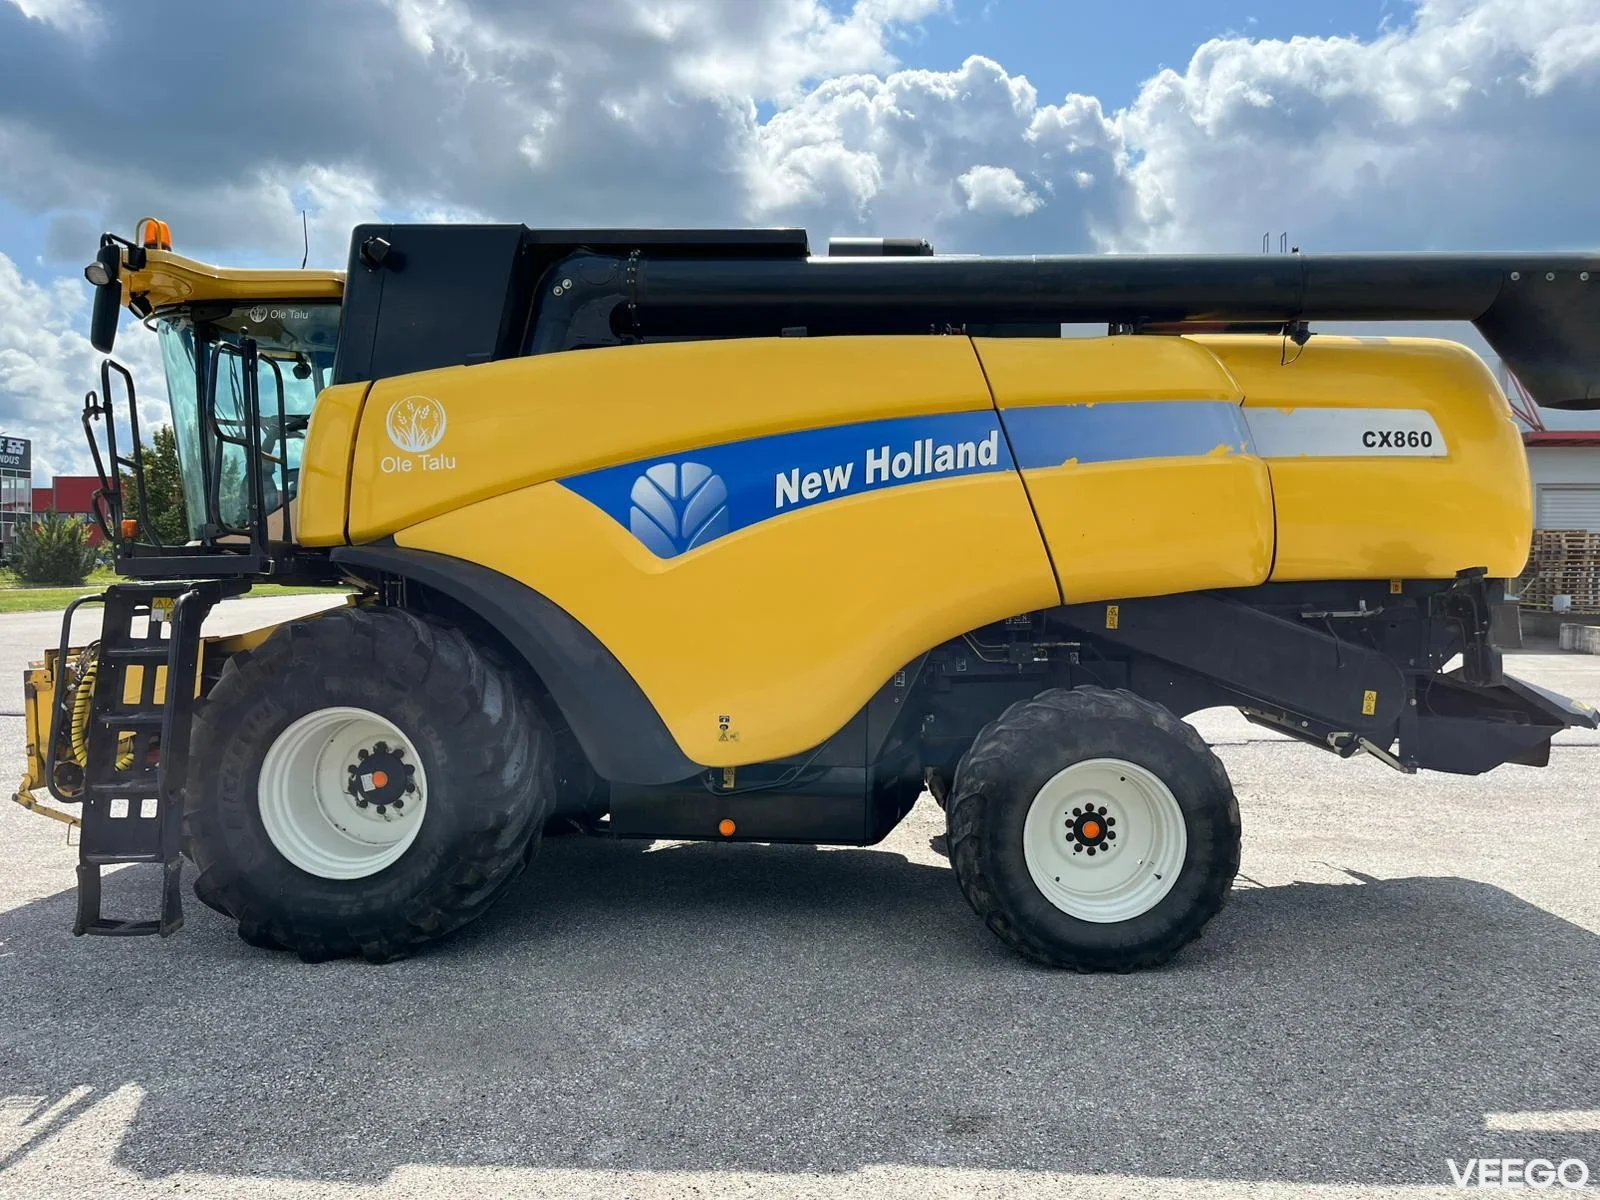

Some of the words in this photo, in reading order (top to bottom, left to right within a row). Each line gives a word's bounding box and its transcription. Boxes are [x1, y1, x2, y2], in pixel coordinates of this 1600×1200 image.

[270, 309, 287, 319] Ole
[287, 308, 309, 319] Talu
[1362, 431, 1433, 448] CX860
[381, 456, 413, 473] Ole
[418, 453, 456, 471] Talu
[775, 461, 854, 509] New
[865, 430, 998, 485] Holland
